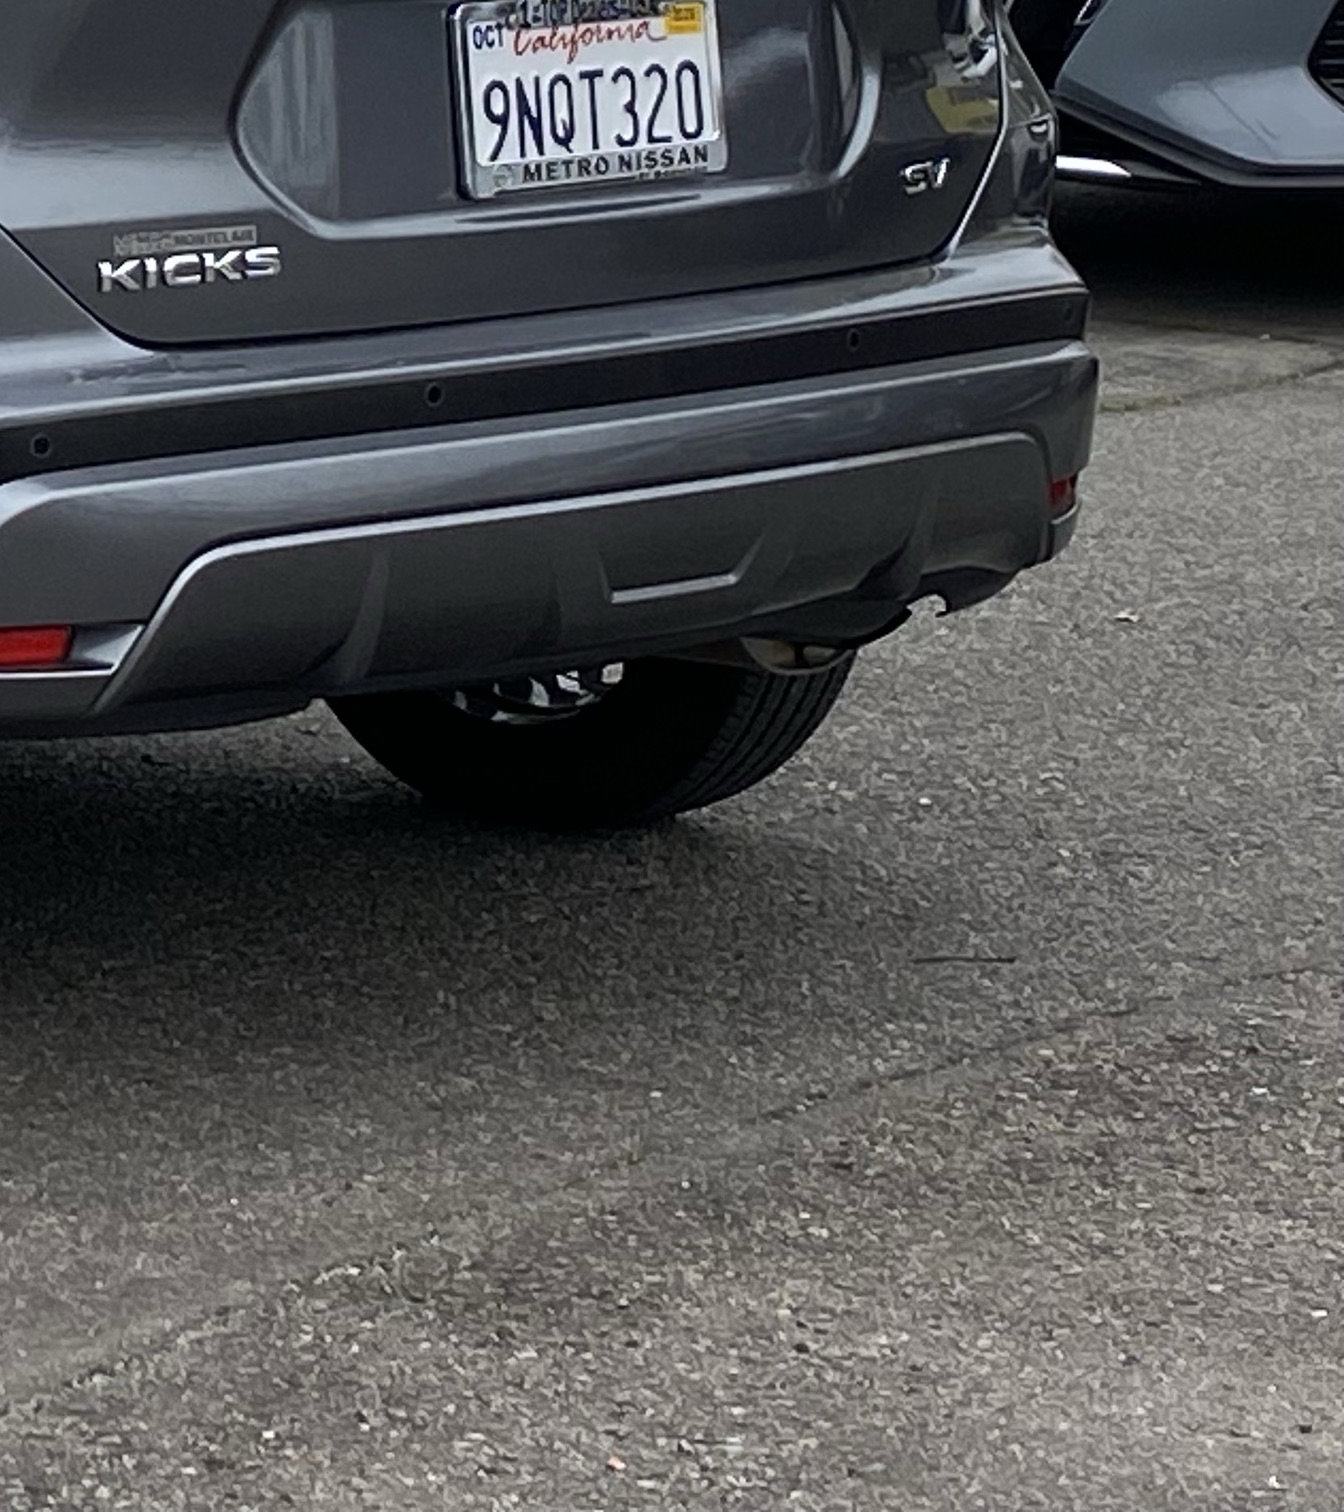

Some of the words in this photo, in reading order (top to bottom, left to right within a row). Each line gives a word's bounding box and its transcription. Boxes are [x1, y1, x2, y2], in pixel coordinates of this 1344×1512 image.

[473, 20, 505, 50] OCT
[513, 19, 668, 64] California
[483, 59, 704, 162] 9NQT320
[522, 159, 611, 184] METRO
[617, 144, 709, 173] NISSAN
[97, 246, 282, 292] KICKS
